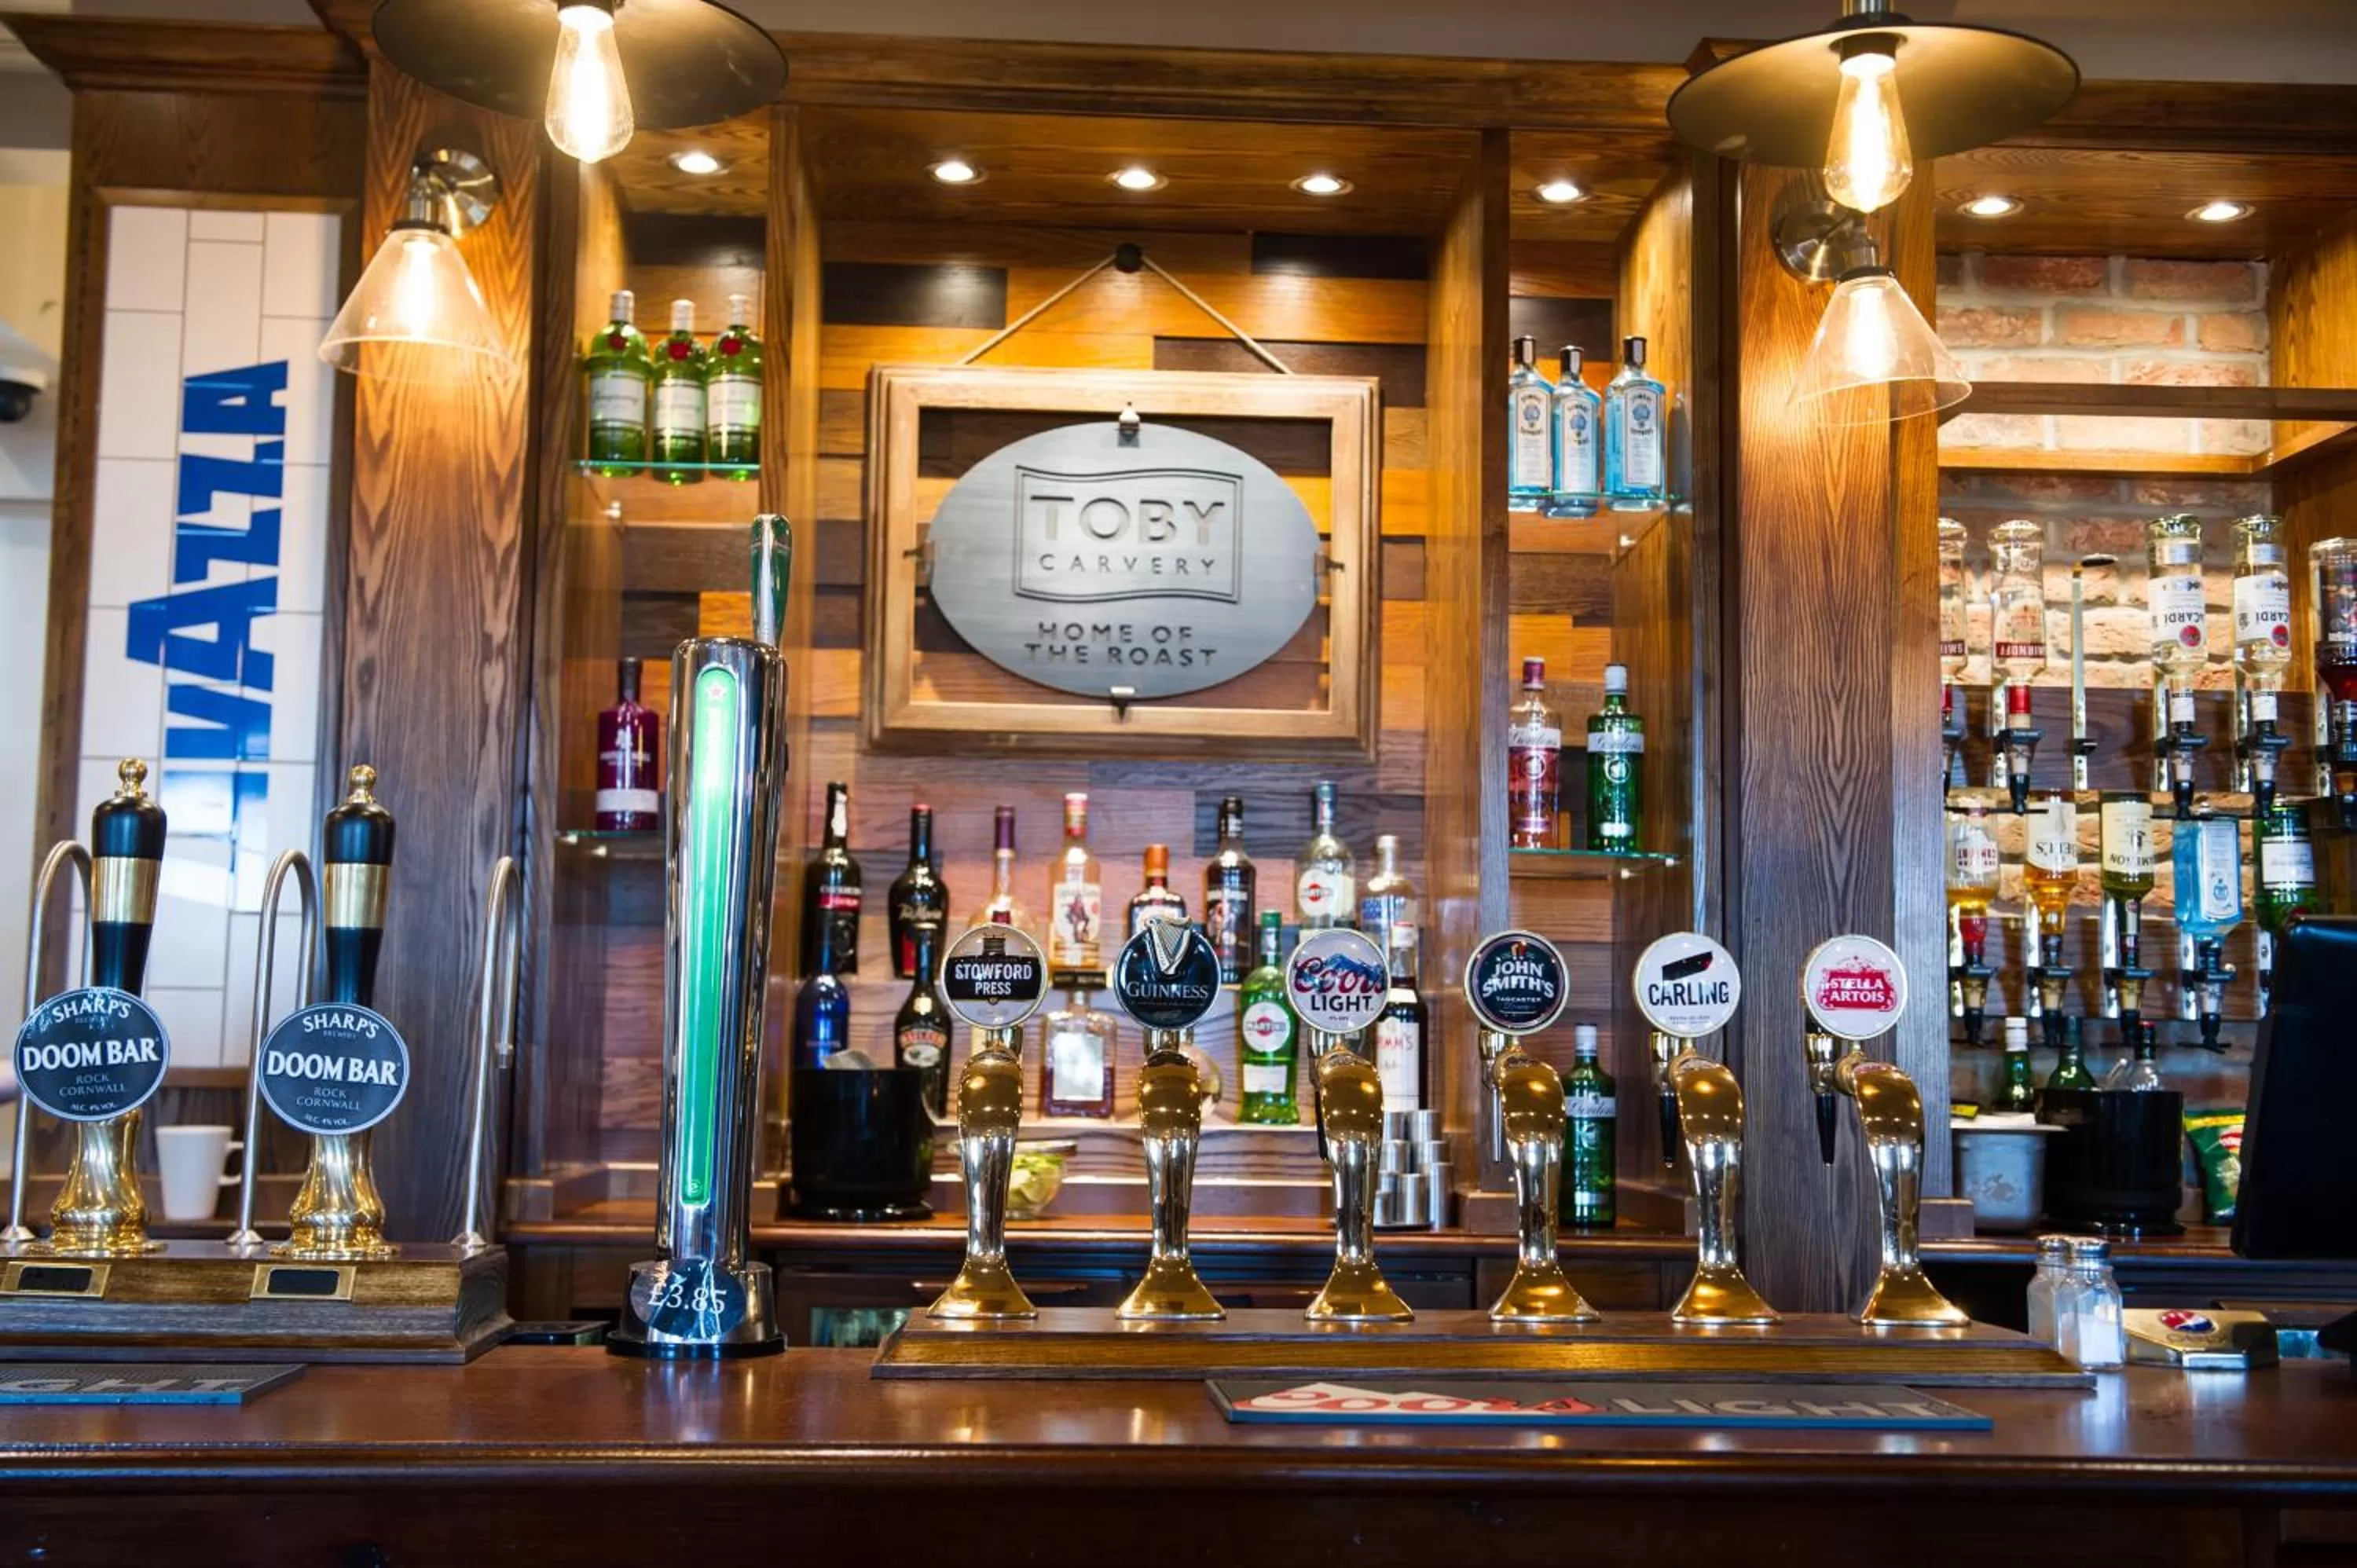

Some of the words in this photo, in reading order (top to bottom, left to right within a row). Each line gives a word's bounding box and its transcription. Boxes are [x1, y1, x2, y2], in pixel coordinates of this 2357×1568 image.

[1030, 496, 1225, 546] TOBY
[1039, 553, 1215, 577] CARVERY
[1038, 621, 1134, 643] HOME
[1151, 625, 1193, 644] OF
[1025, 643, 1090, 664] THE
[1108, 646, 1219, 667] ROAST
[955, 963, 1032, 980] STOWFORD
[1294, 956, 1385, 994] Coors
[1492, 960, 1544, 978] JOHN
[975, 981, 1012, 995] PRESS
[1126, 981, 1208, 998] GUINNESS
[1483, 975, 1554, 998] SMITH'S
[1648, 980, 1729, 1006] CARLING
[1829, 978, 1884, 989] STELLA
[1310, 995, 1372, 1012] LIGHT
[1830, 991, 1886, 1003] ARTOIS
[52, 998, 132, 1023] SHARP'S
[302, 1012, 379, 1039] SHARP'S
[23, 1041, 103, 1072] DOOM
[106, 1037, 161, 1064] BAR
[266, 1050, 346, 1081] DOOM
[347, 1057, 398, 1086] BAR
[75, 1073, 110, 1085] ROCK
[59, 1083, 127, 1097] CORNWALL
[314, 1087, 346, 1098] ROCK
[296, 1096, 361, 1111] CORNWALL
[648, 1281, 728, 1315] £3.85
[1611, 1398, 1941, 1418] LIGHT
